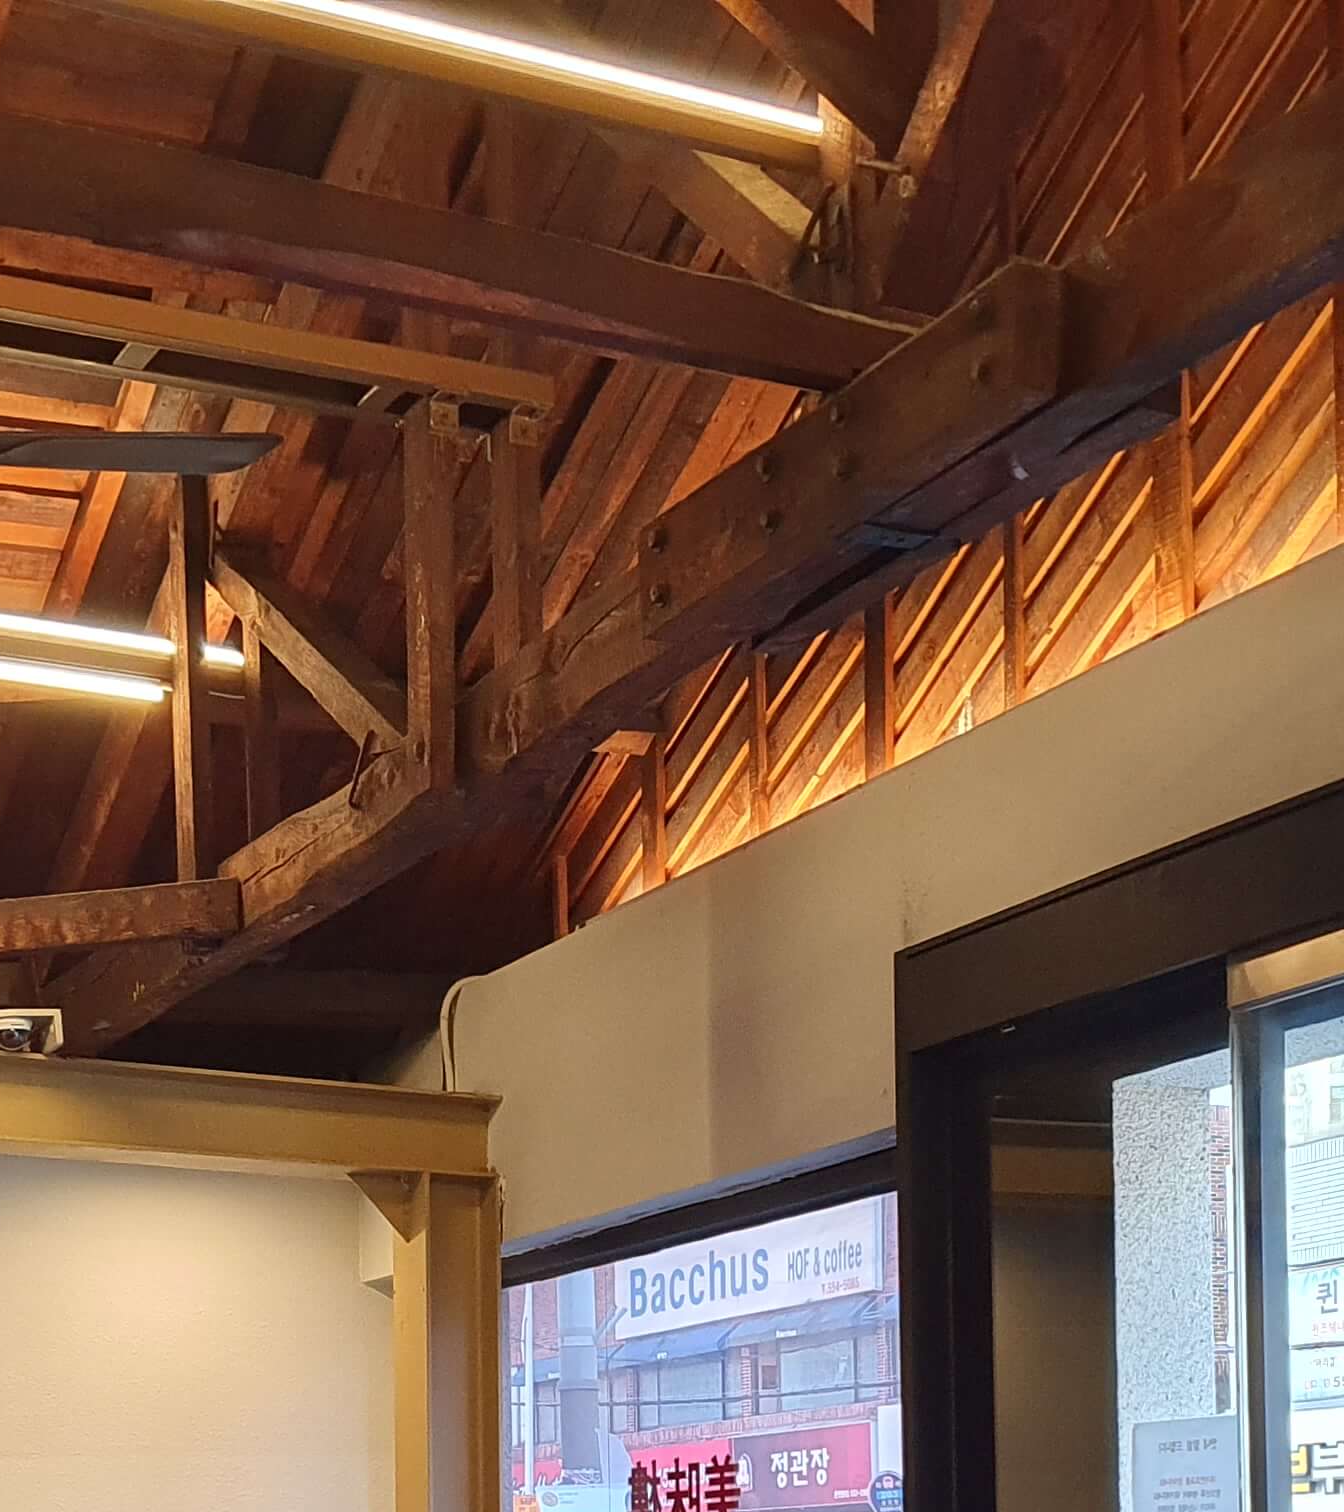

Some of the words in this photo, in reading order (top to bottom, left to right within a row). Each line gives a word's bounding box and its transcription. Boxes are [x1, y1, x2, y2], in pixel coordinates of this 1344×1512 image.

[630, 1249, 768, 1318] Bacchus
[787, 1250, 810, 1281] HOF
[813, 1247, 821, 1275] &
[824, 1240, 862, 1273] coffee
[769, 1447, 830, 1489] 정관장
